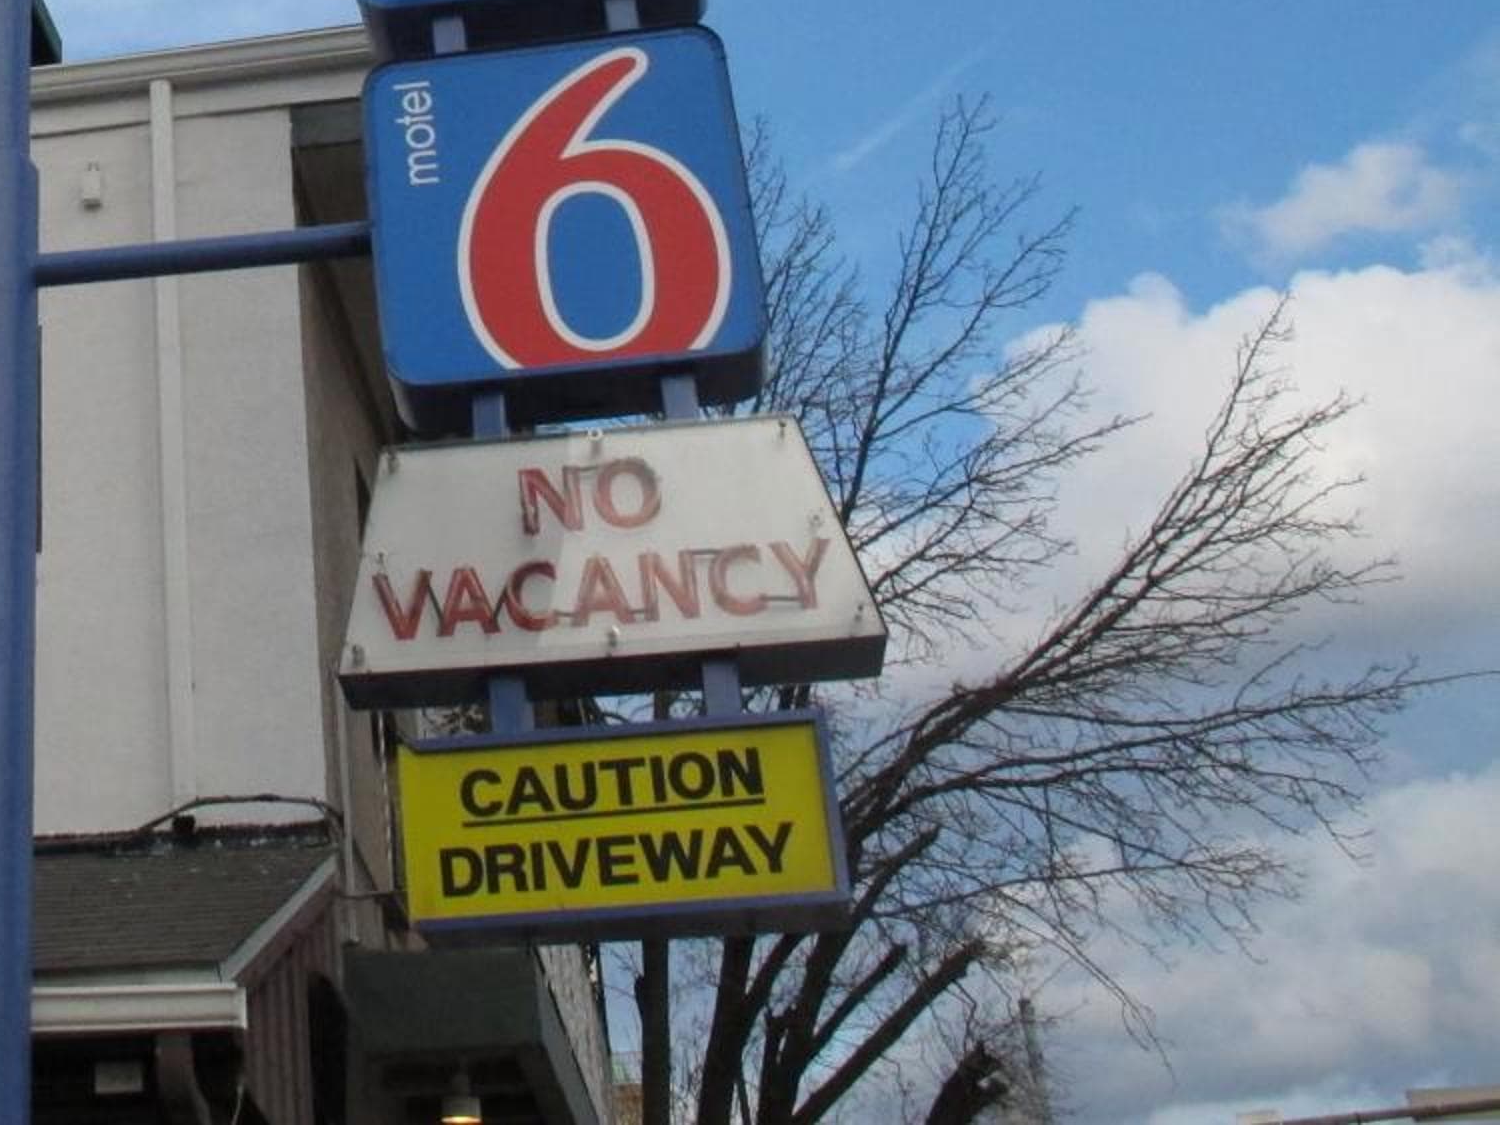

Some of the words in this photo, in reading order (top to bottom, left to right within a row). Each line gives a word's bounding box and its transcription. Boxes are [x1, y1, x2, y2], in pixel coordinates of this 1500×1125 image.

[392, 81, 440, 187] motel
[458, 46, 732, 370] 6
[517, 456, 662, 536] NO
[371, 538, 831, 641] VACANCY
[460, 747, 764, 818] CAUTION
[439, 822, 793, 898] DRIVEWAY
